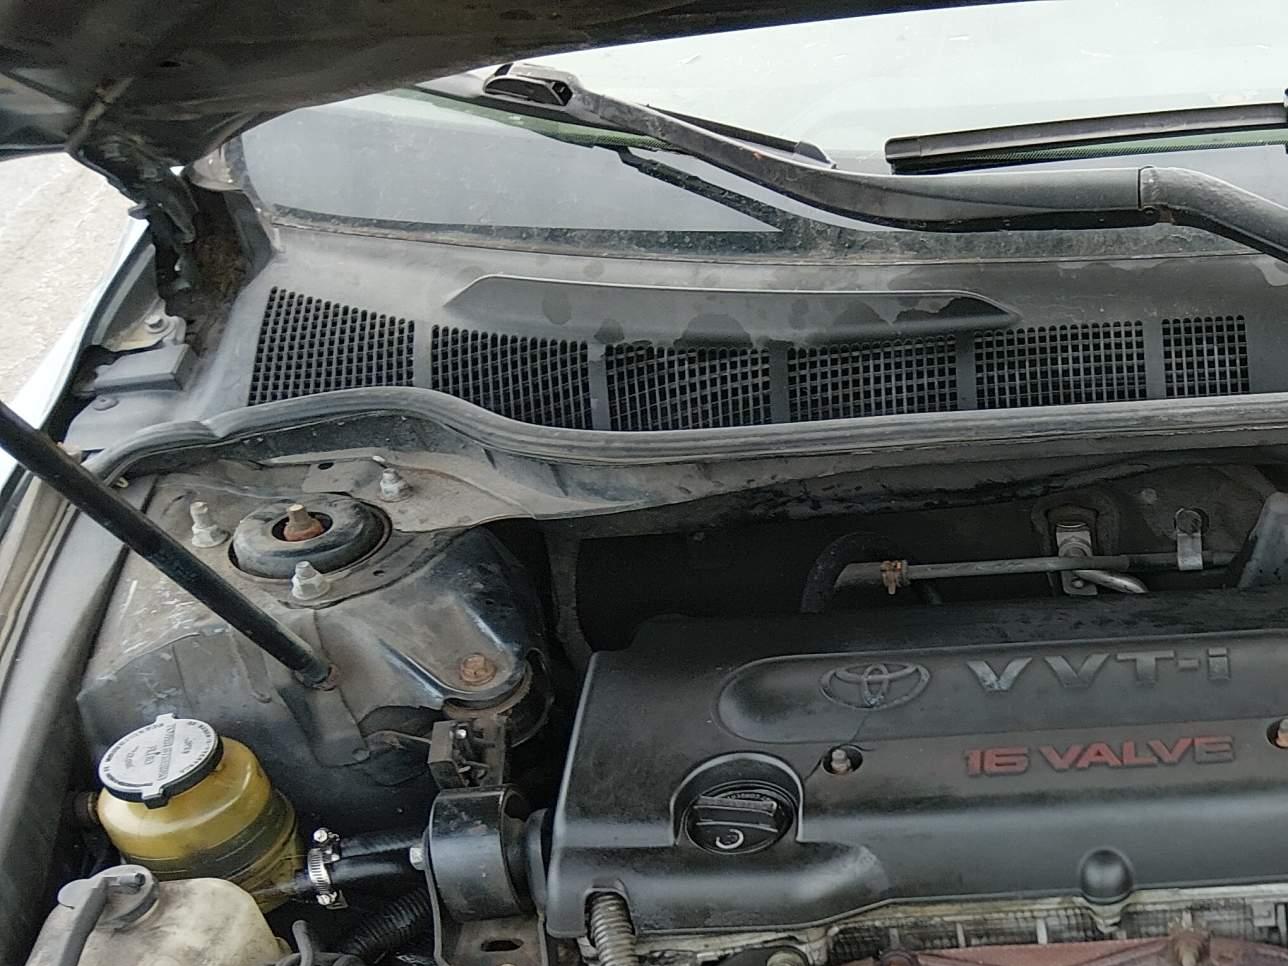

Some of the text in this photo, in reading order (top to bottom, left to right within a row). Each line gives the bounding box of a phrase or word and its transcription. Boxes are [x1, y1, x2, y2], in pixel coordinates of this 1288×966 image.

[967, 648, 1230, 692] VVT-i
[966, 735, 1236, 777] 16 VALVE
